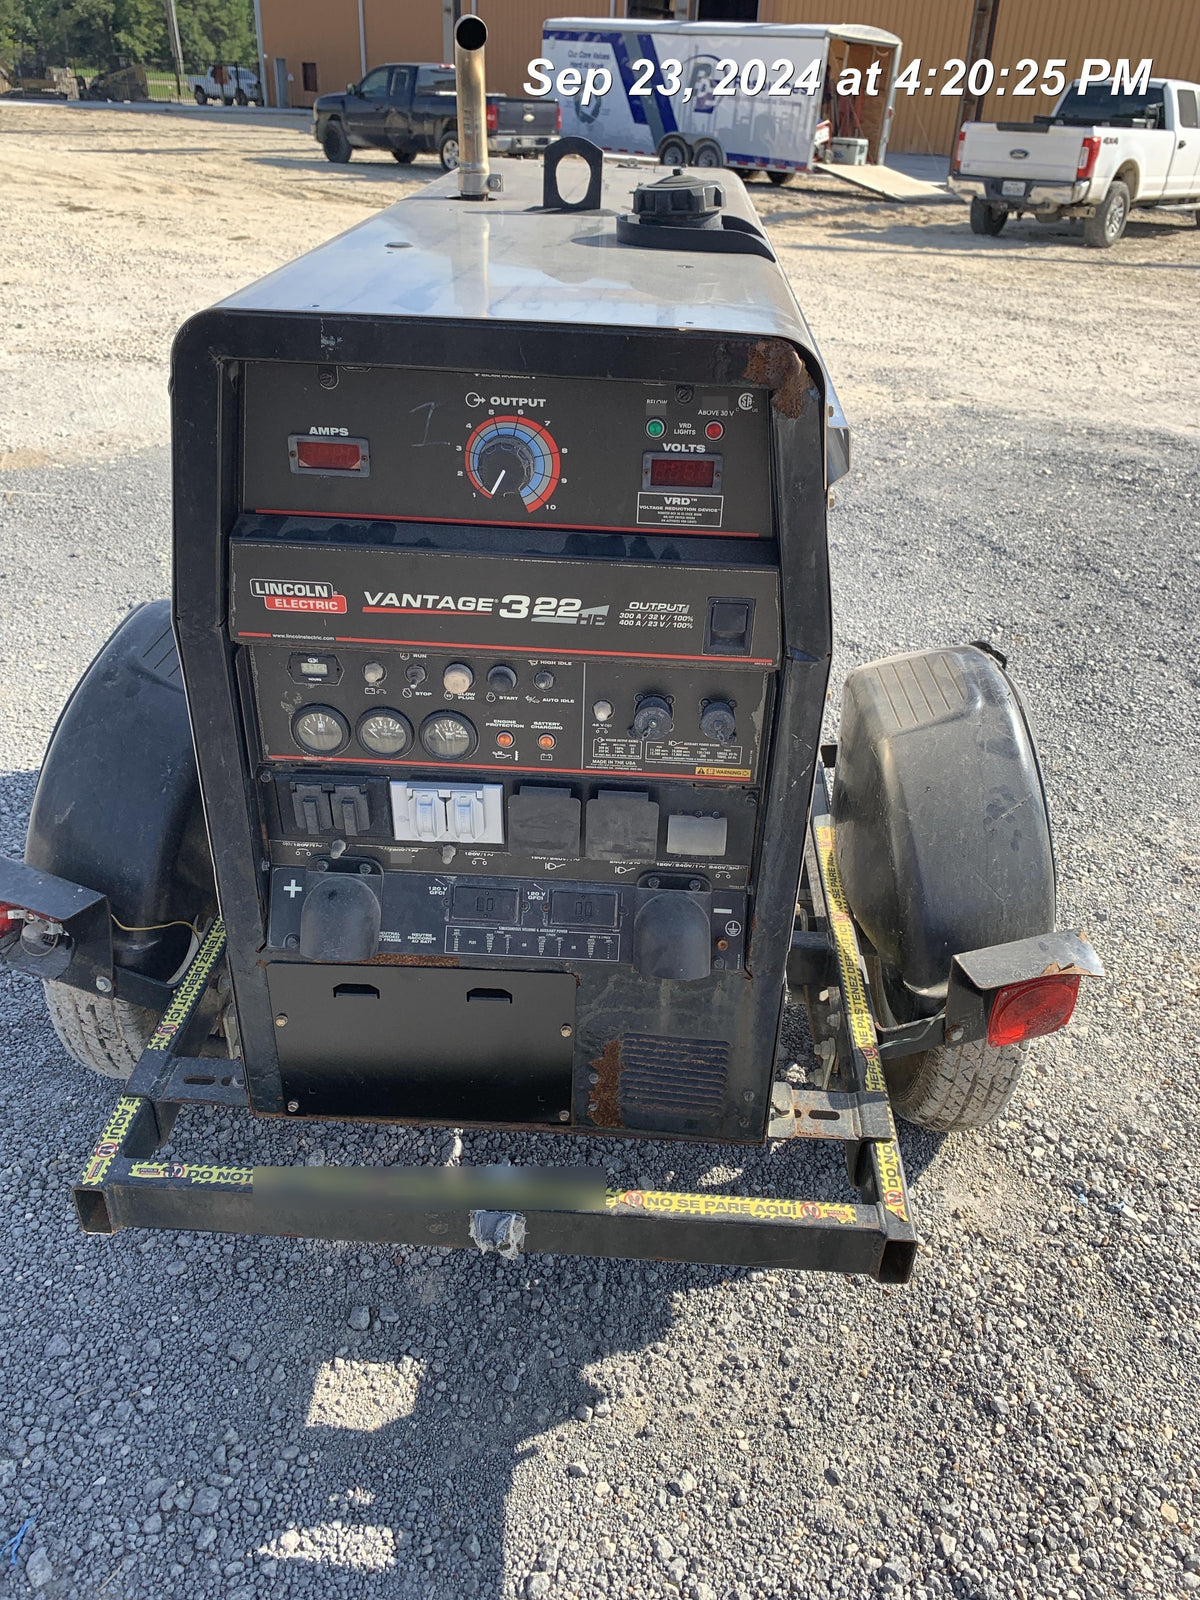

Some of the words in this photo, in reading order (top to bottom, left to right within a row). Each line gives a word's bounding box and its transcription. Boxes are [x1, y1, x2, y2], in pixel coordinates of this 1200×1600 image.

[490, 396, 546, 408] OUTPUT
[697, 409, 719, 417] ABOVE
[308, 426, 350, 437] AMPS
[662, 443, 706, 453] VOLTS
[254, 582, 329, 598] LINCOLN
[274, 598, 339, 611] ELECTRIC
[628, 601, 687, 612] OUTPUT
[618, 612, 635, 620] 300
[272, 633, 335, 641] www.lincolnelectric.com
[827, 867, 839, 887] PARE
[200, 934, 220, 963] TENEZ
[179, 965, 205, 1007] DEBOUT
[847, 975, 862, 1007] TENEZ
[167, 1008, 185, 1023] ICI
[854, 1007, 867, 1029] PAS
[859, 1030, 869, 1046] NE
[186, 1169, 214, 1180] DO
[885, 1168, 898, 1188] DO
[646, 1196, 674, 1207] NO
[677, 1198, 701, 1209] SE
[704, 1200, 751, 1214] PARE
